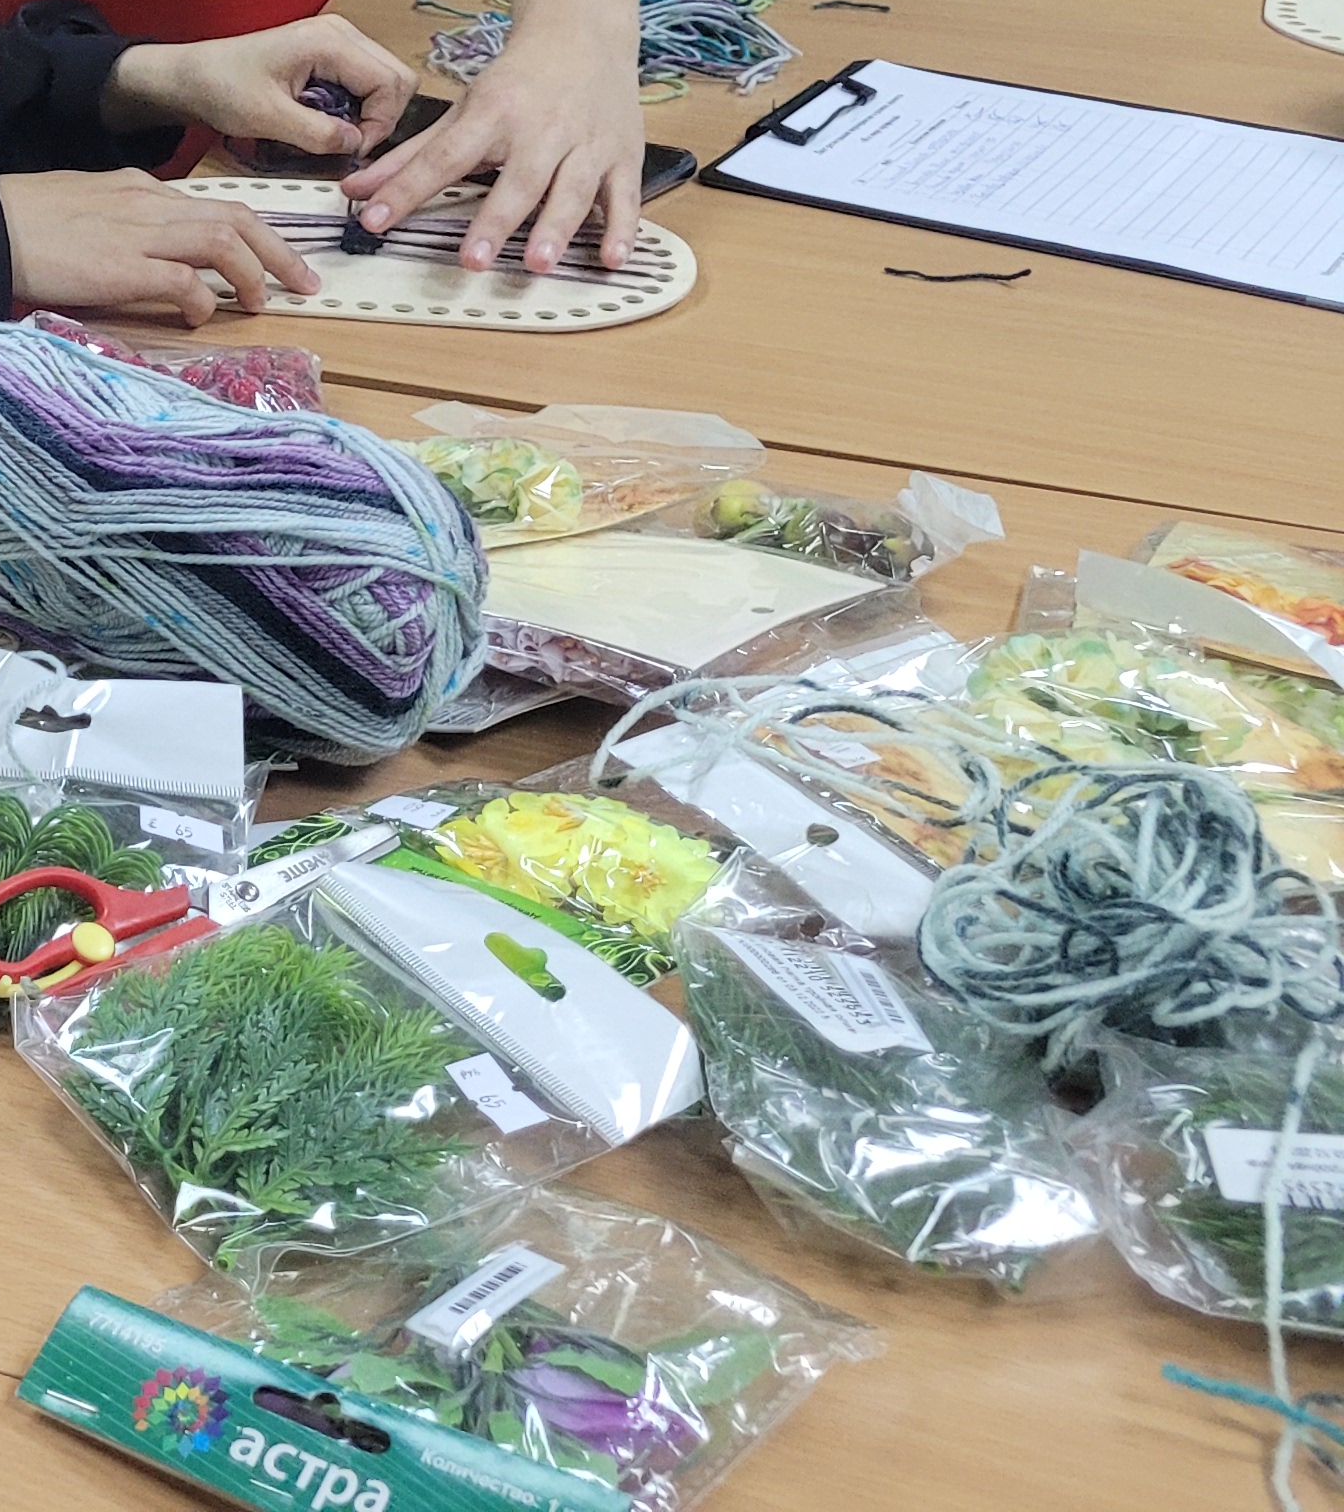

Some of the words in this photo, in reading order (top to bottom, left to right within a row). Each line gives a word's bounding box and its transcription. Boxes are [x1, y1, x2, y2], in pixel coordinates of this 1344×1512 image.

[175, 824, 193, 838] 65
[479, 1094, 507, 1108] 65
[88, 1311, 165, 1354] 7714195
[229, 1426, 391, 1512] астра
